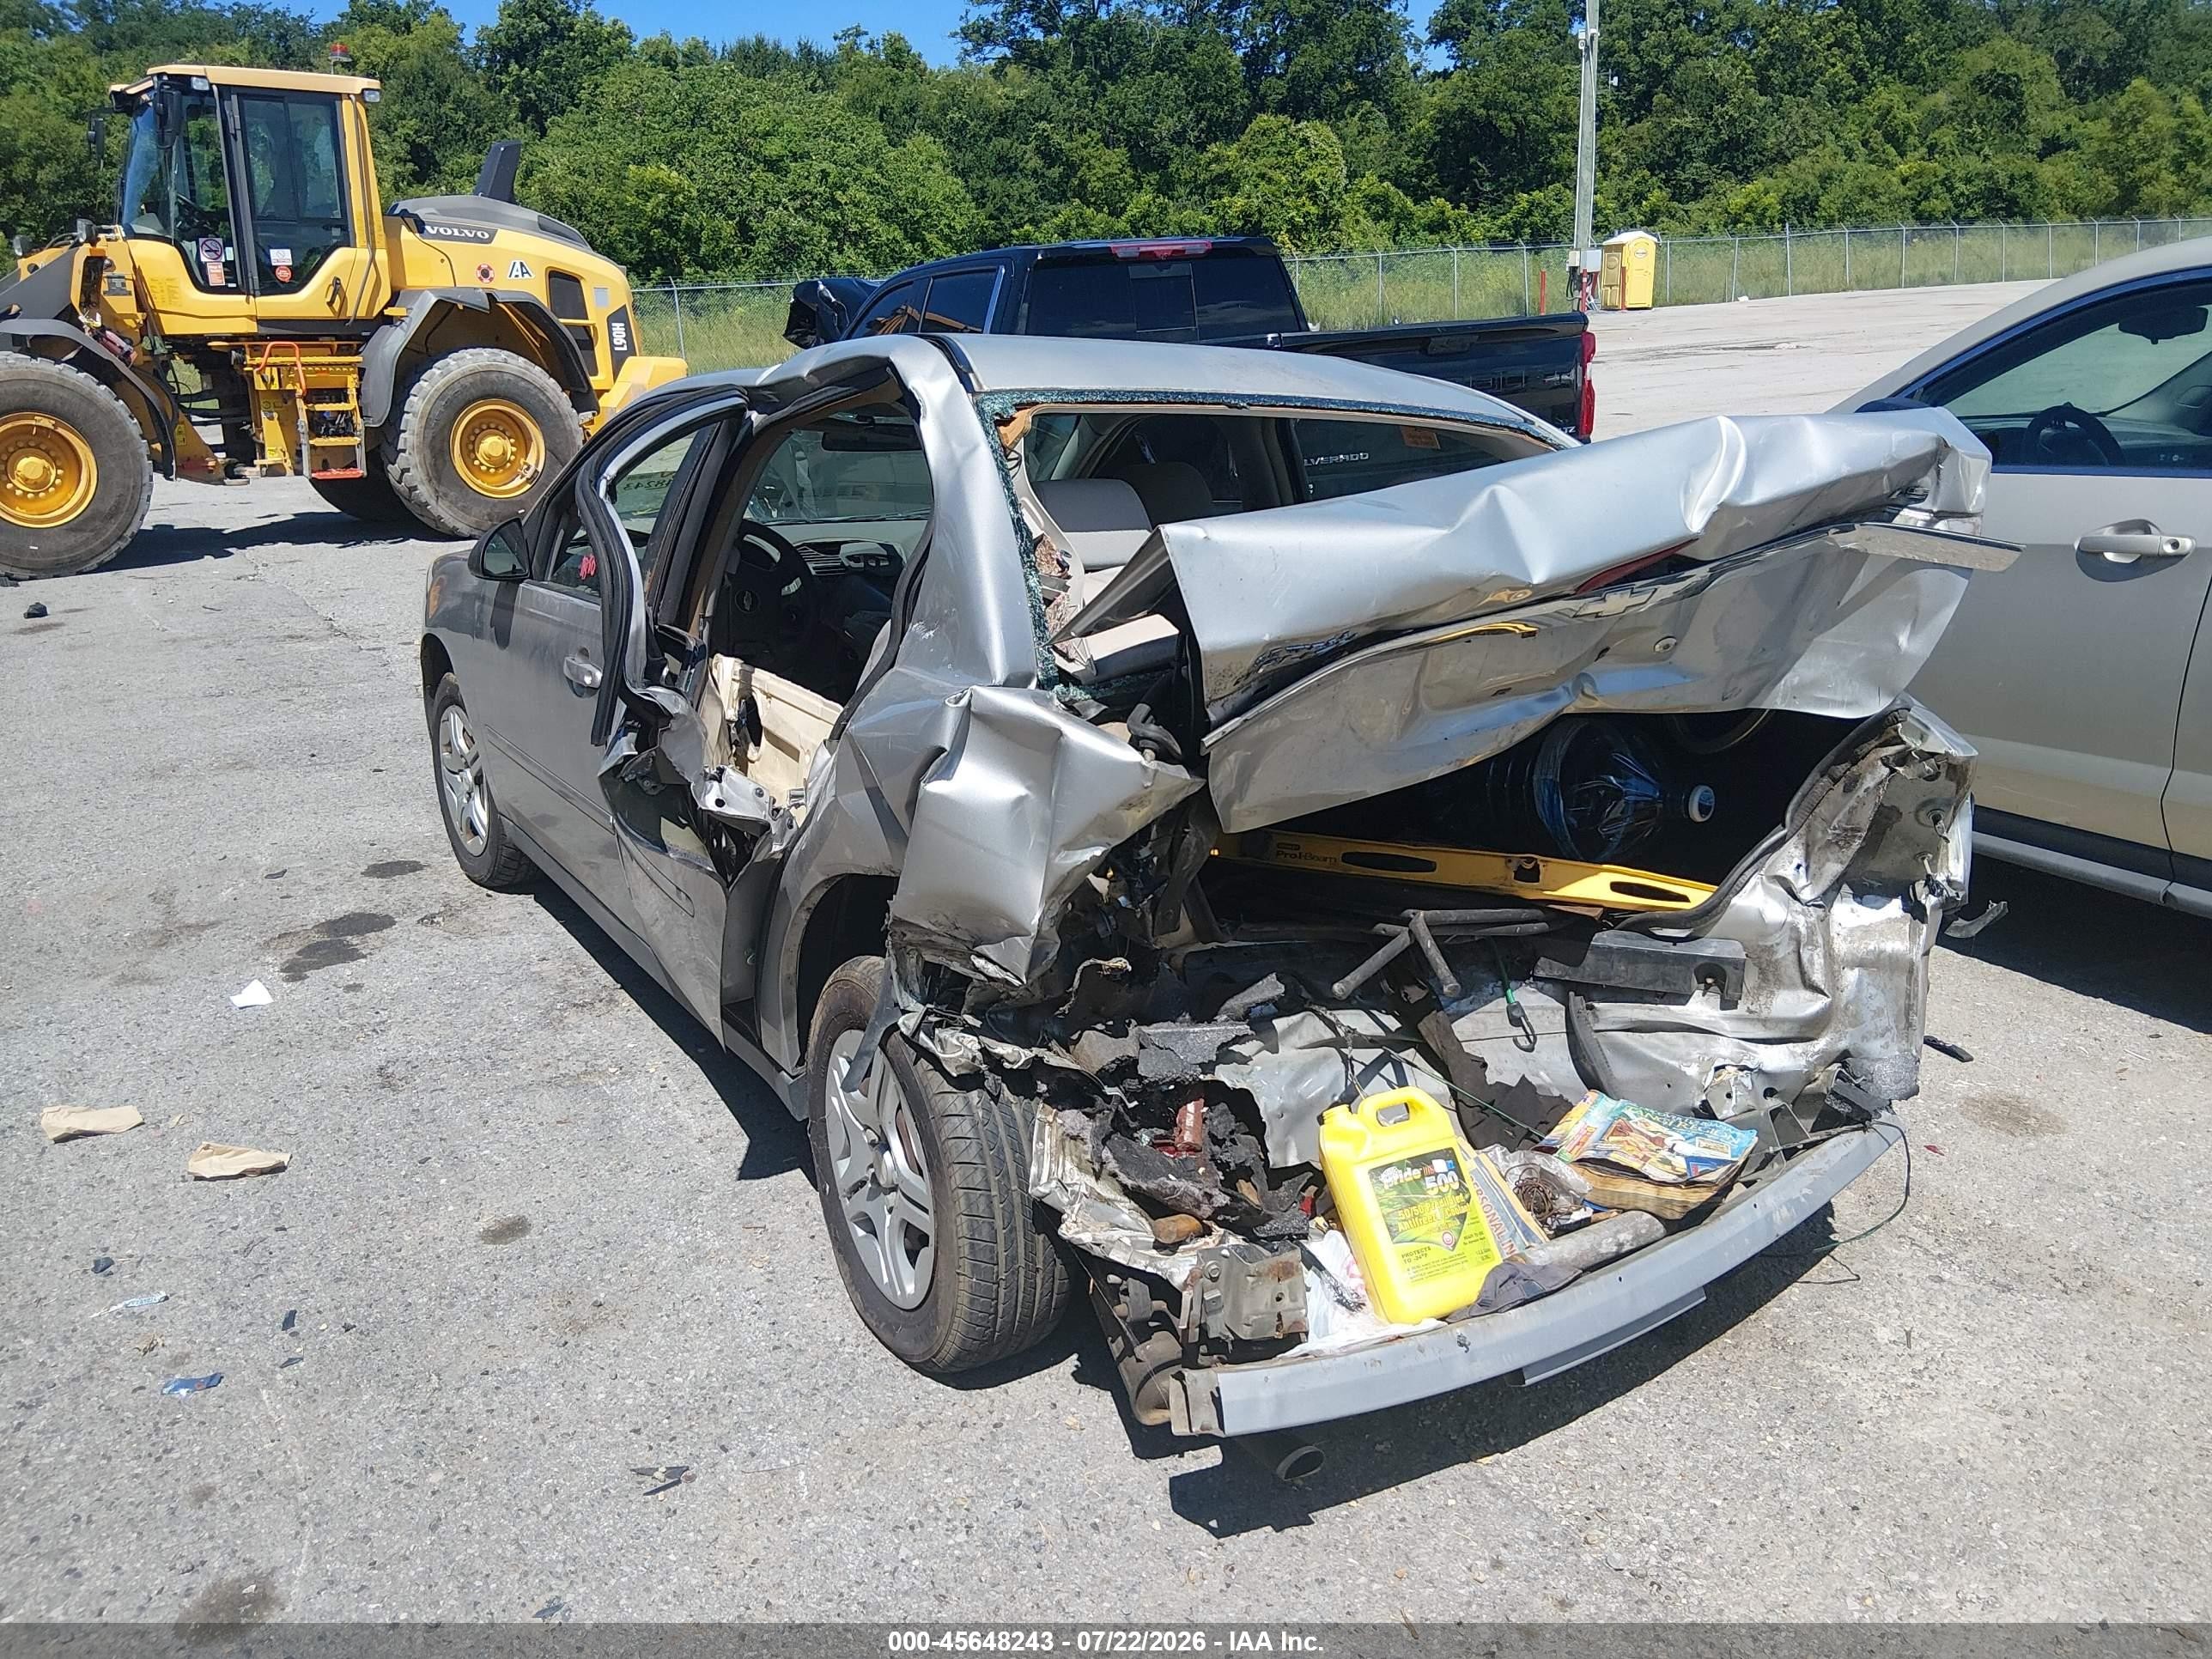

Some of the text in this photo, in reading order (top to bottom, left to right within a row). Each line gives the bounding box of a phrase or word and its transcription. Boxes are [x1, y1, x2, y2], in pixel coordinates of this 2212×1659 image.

[424, 225, 490, 240] VOLVO
[611, 322, 628, 351] L90H
[1559, 425, 1577, 434] TZ
[1425, 1170, 1460, 1196] 500
[1398, 1205, 1425, 1220] 50/50
[1401, 1246, 1431, 1259] PROTECTS
[1403, 1256, 1413, 1265] TO
